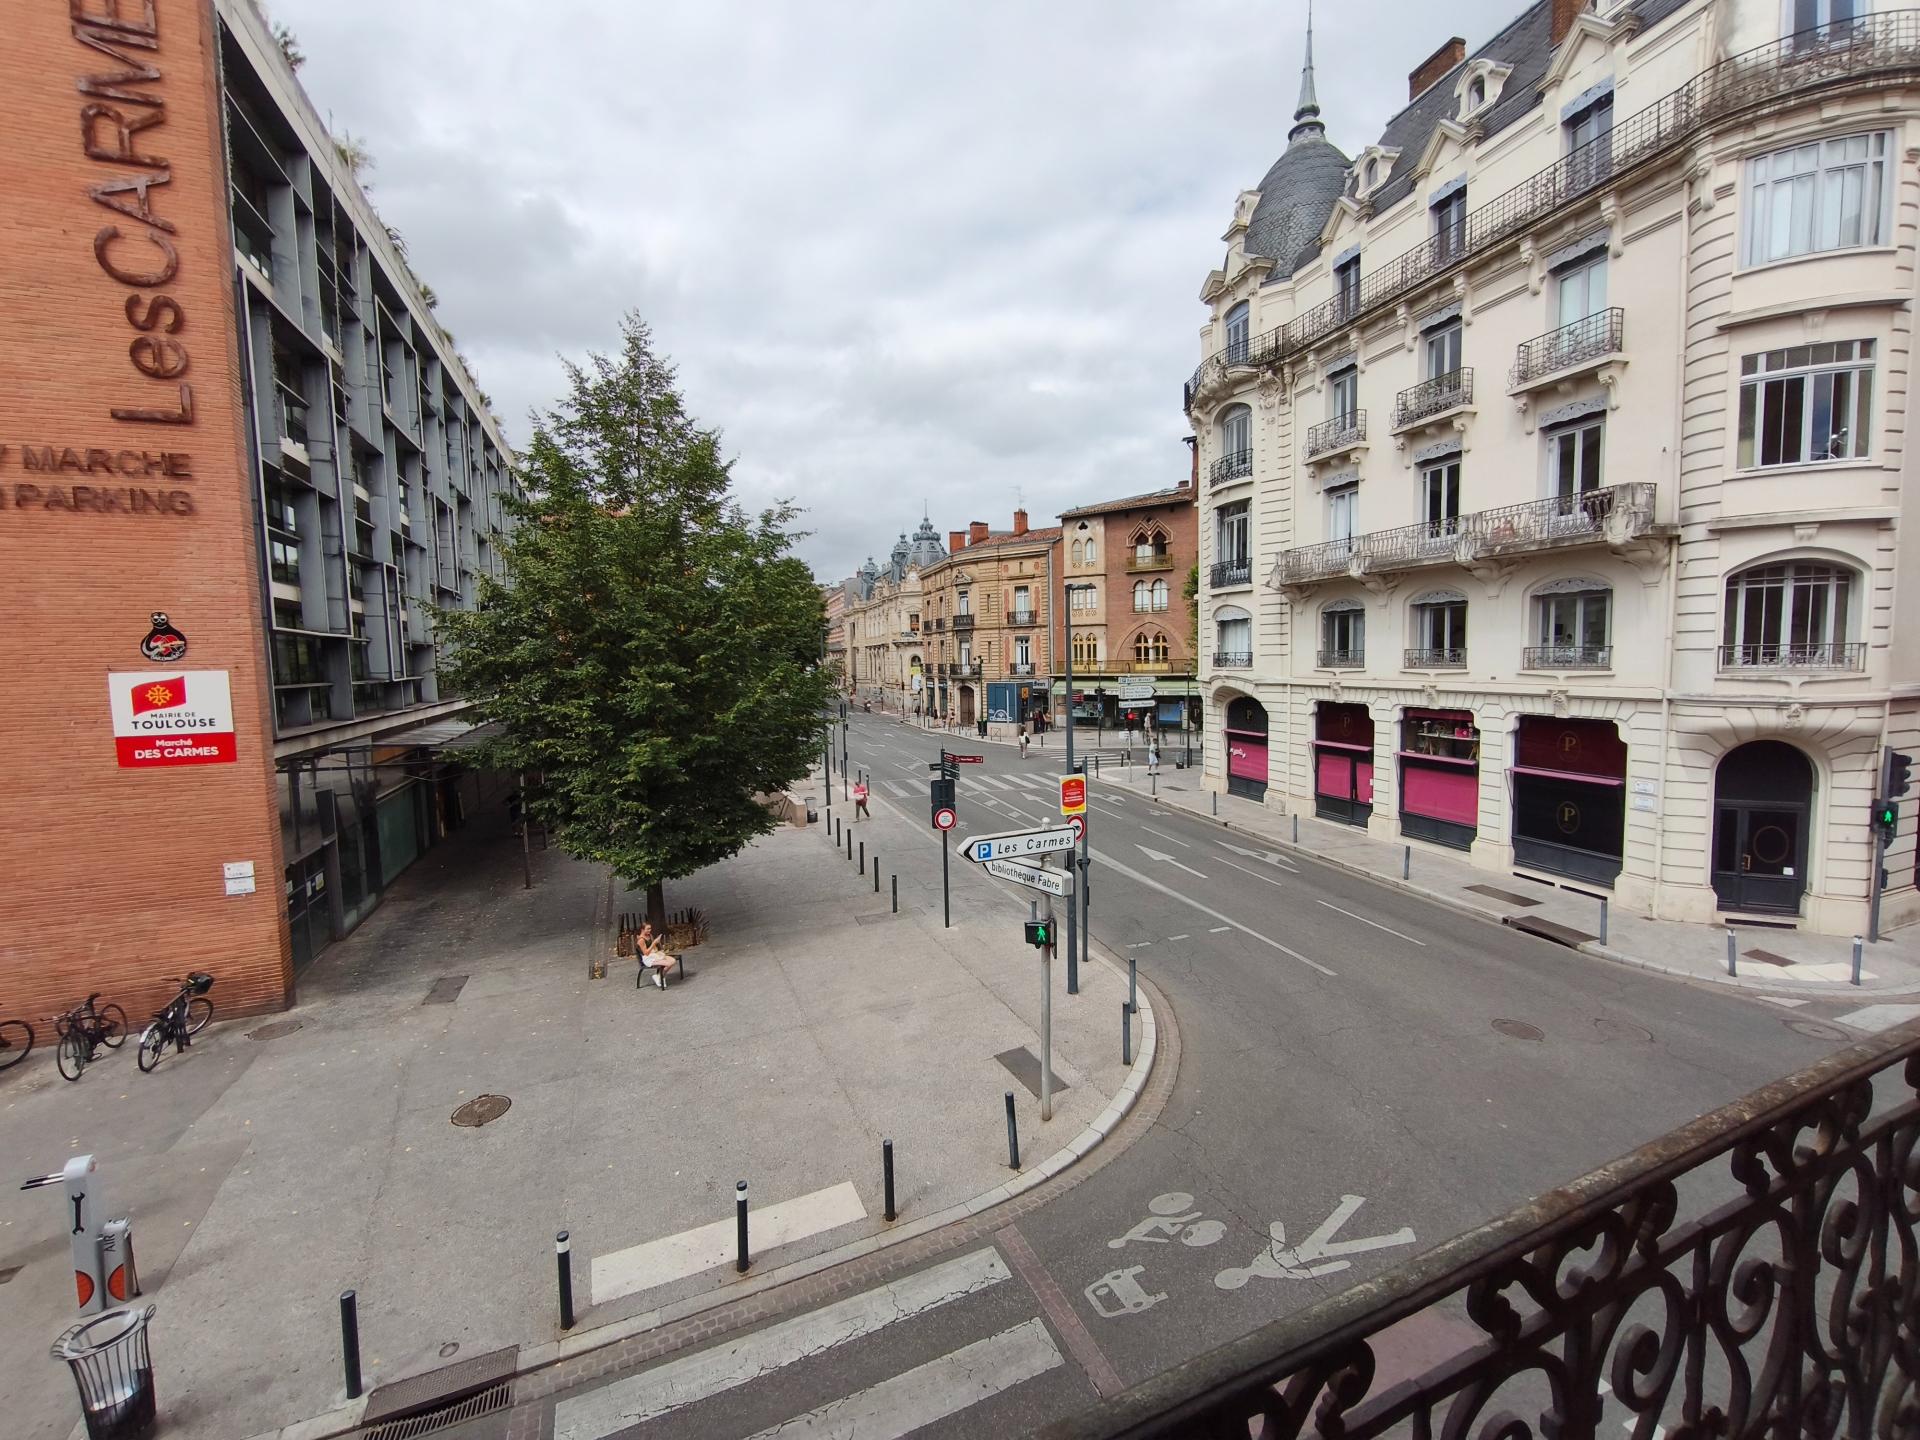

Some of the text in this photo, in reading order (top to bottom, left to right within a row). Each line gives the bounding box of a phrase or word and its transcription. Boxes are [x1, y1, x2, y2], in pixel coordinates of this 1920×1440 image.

[22, 444, 193, 477] MARCHE
[15, 483, 195, 516] PARKING
[131, 717, 217, 730] TOULOUSE
[156, 738, 192, 747] Marché
[1563, 736, 1577, 752] P
[134, 746, 219, 759] DES CARMES
[1563, 807, 1576, 822] P
[997, 842, 1018, 855] Les
[1026, 834, 1071, 850] Carmes
[1037, 874, 1060, 891] Fabre
[103, 1234, 116, 1252] AIR
